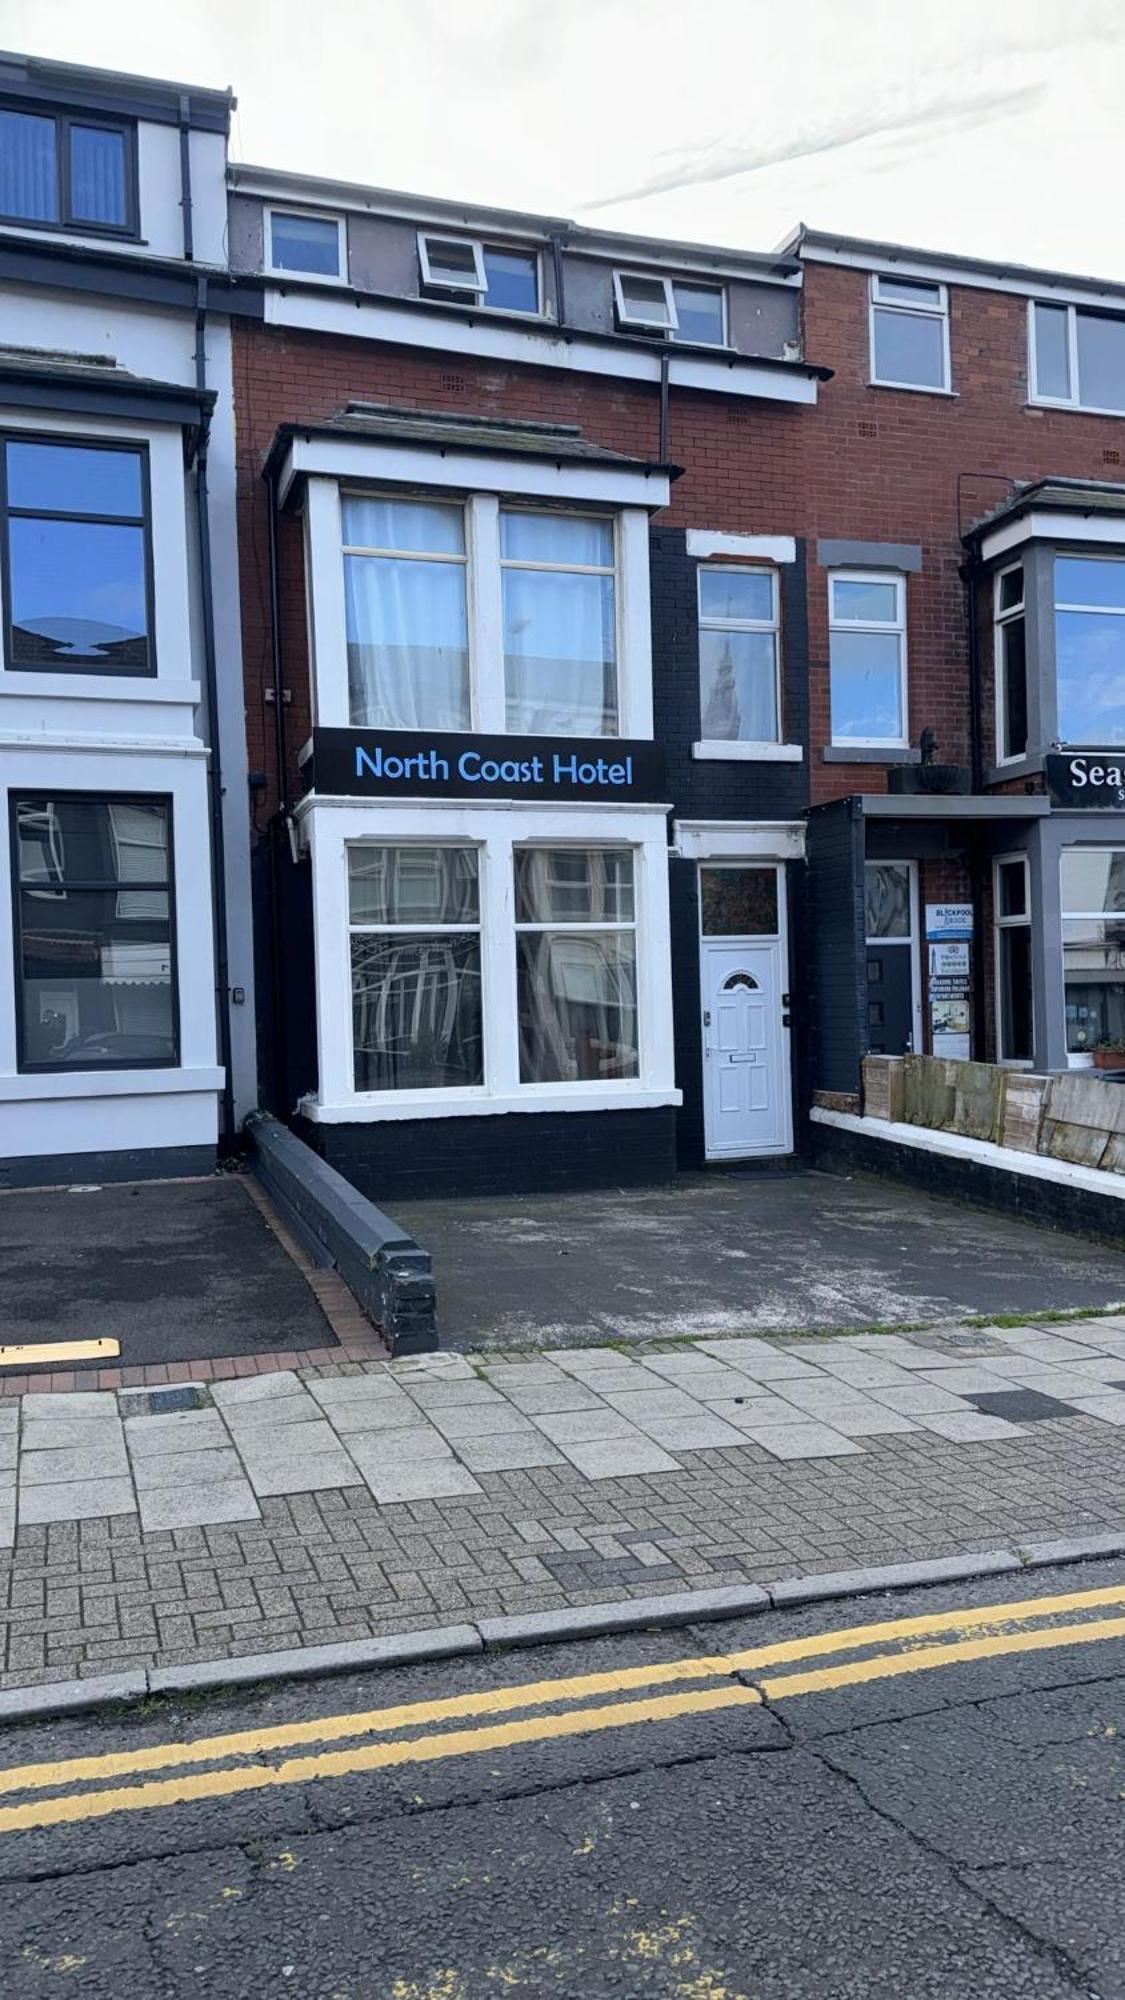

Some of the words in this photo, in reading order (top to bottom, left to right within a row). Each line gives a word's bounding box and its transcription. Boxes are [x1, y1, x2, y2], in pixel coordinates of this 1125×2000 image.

[355, 746, 449, 780] North
[458, 752, 543, 782] Coast
[553, 754, 633, 785] Hotel
[1069, 758, 1125, 787] Sea
